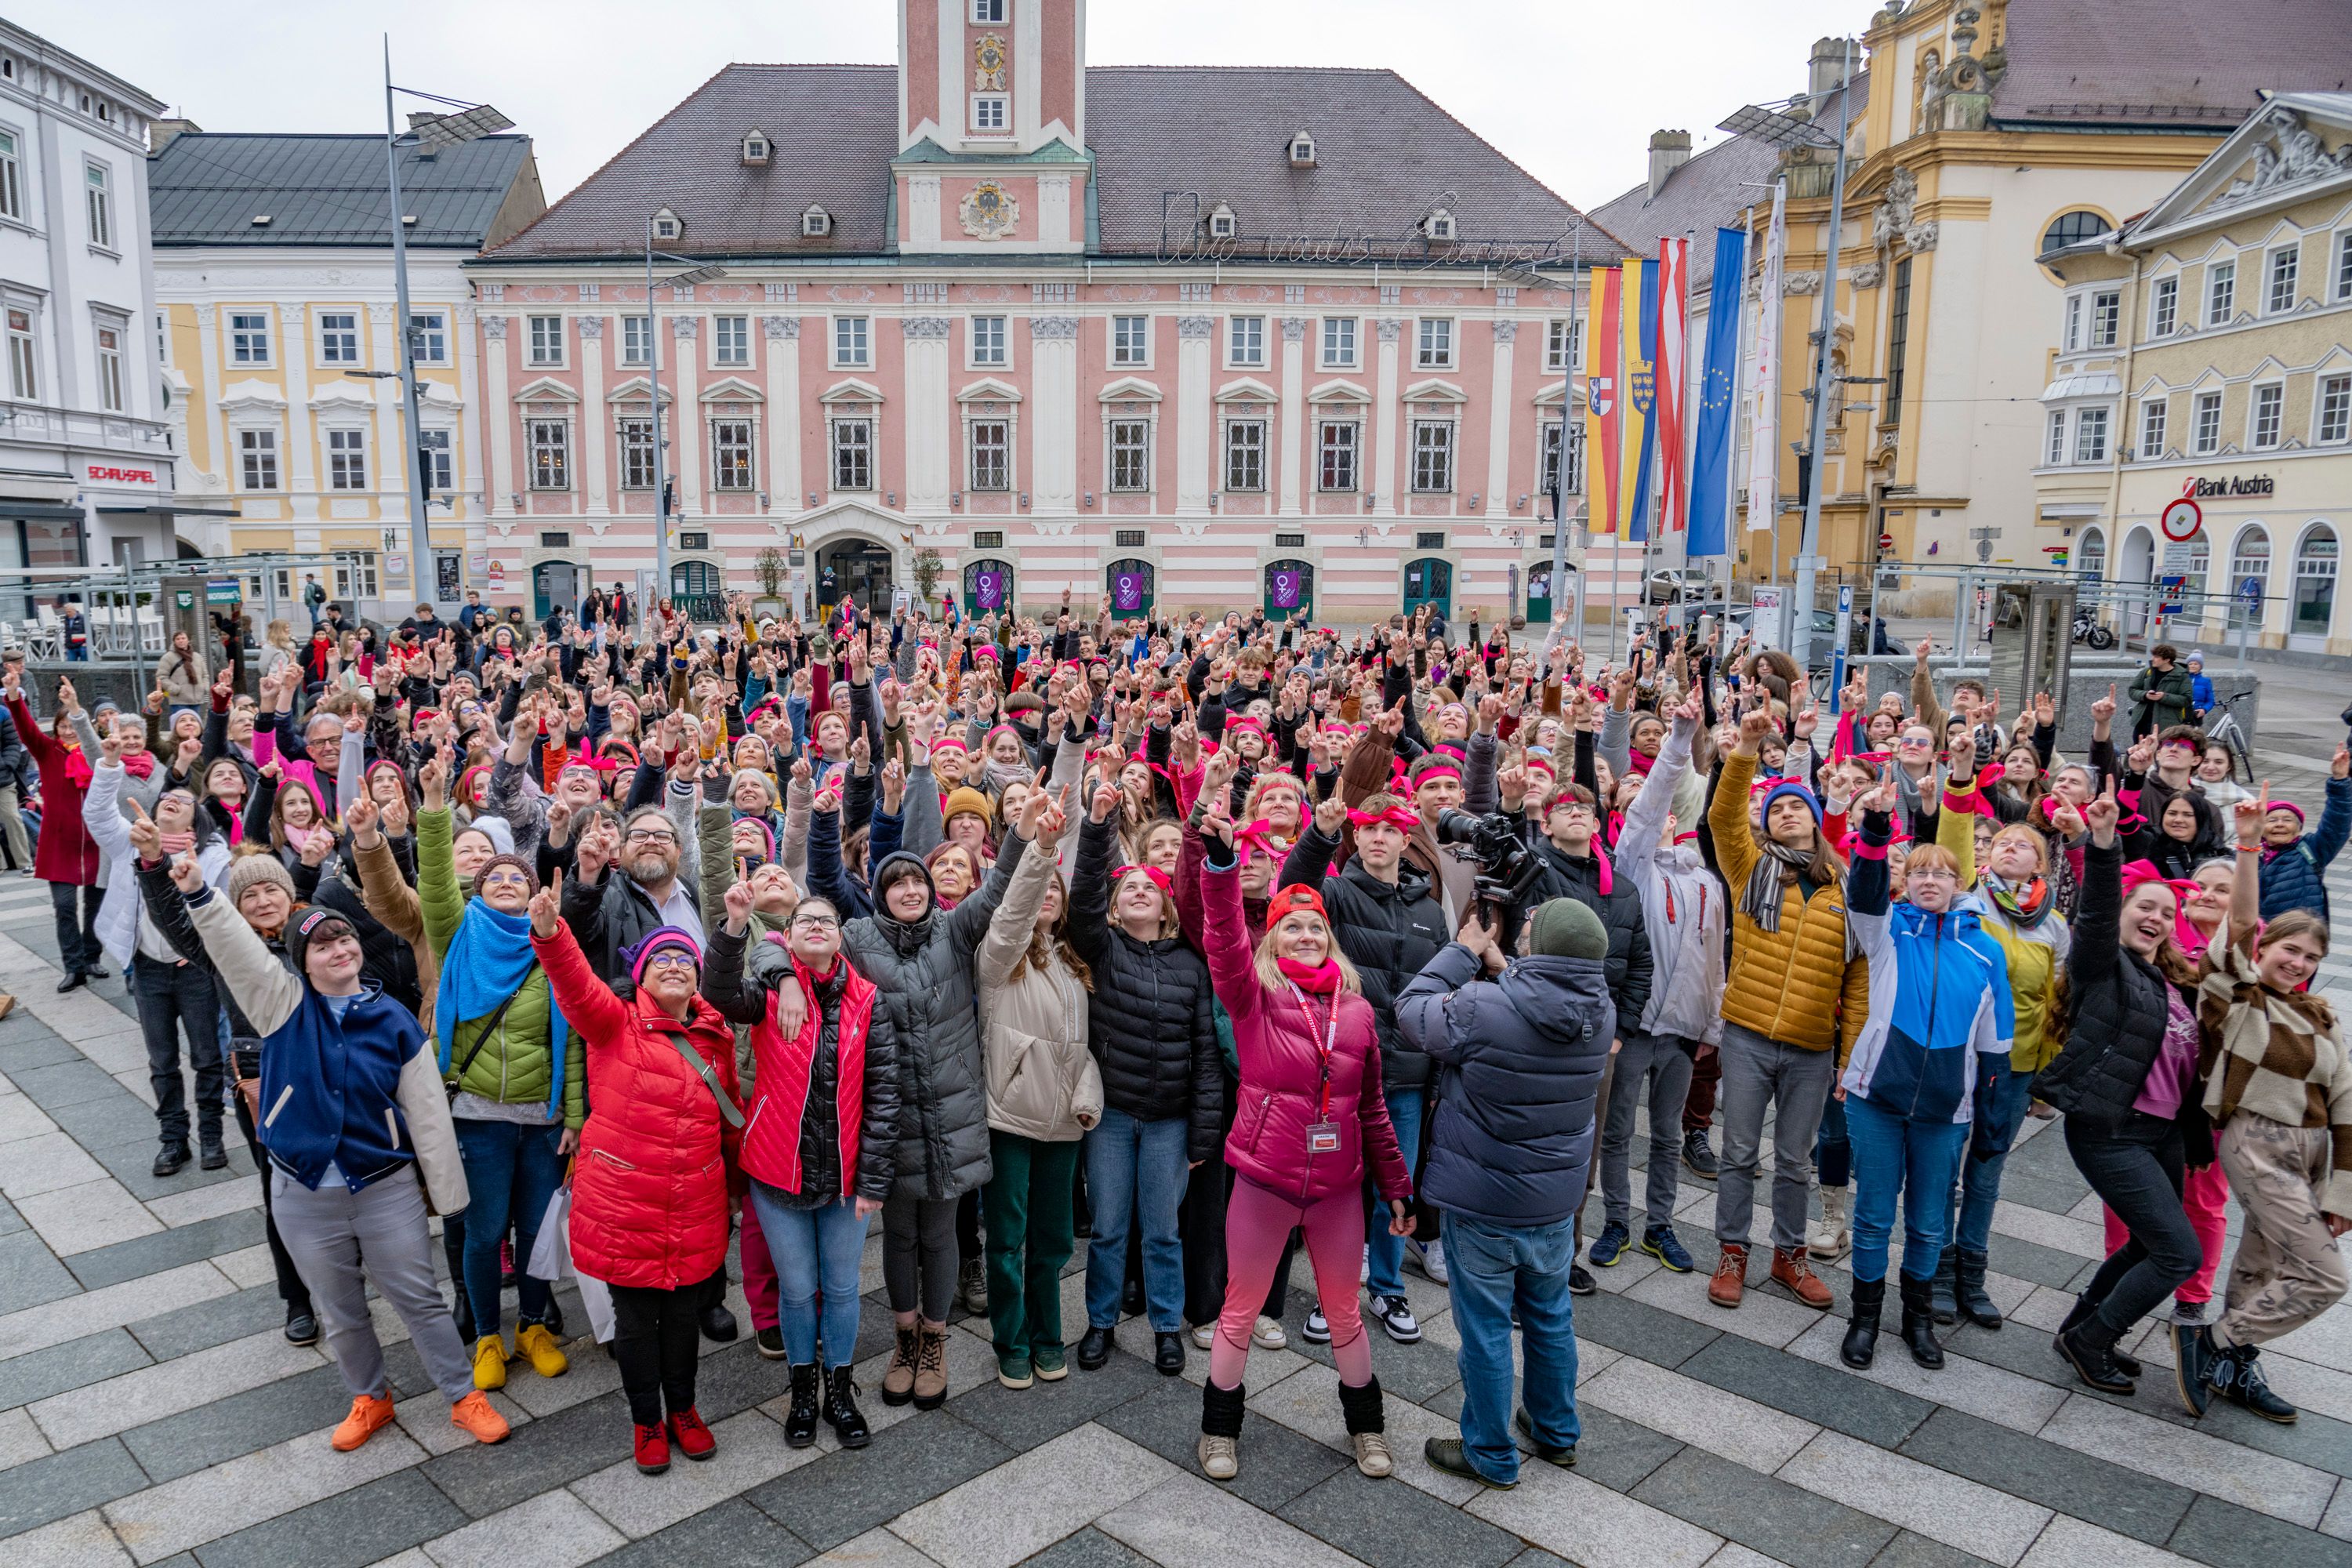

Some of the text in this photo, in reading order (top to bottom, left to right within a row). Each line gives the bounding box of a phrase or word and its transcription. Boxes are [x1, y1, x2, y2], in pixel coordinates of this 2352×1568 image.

[1268, 216, 1370, 267] vadis
[2197, 474, 2274, 496] Bank Austria
[177, 593, 192, 602] WC
[1302, 1005, 1323, 1051] #VISITSTPOELTEN
